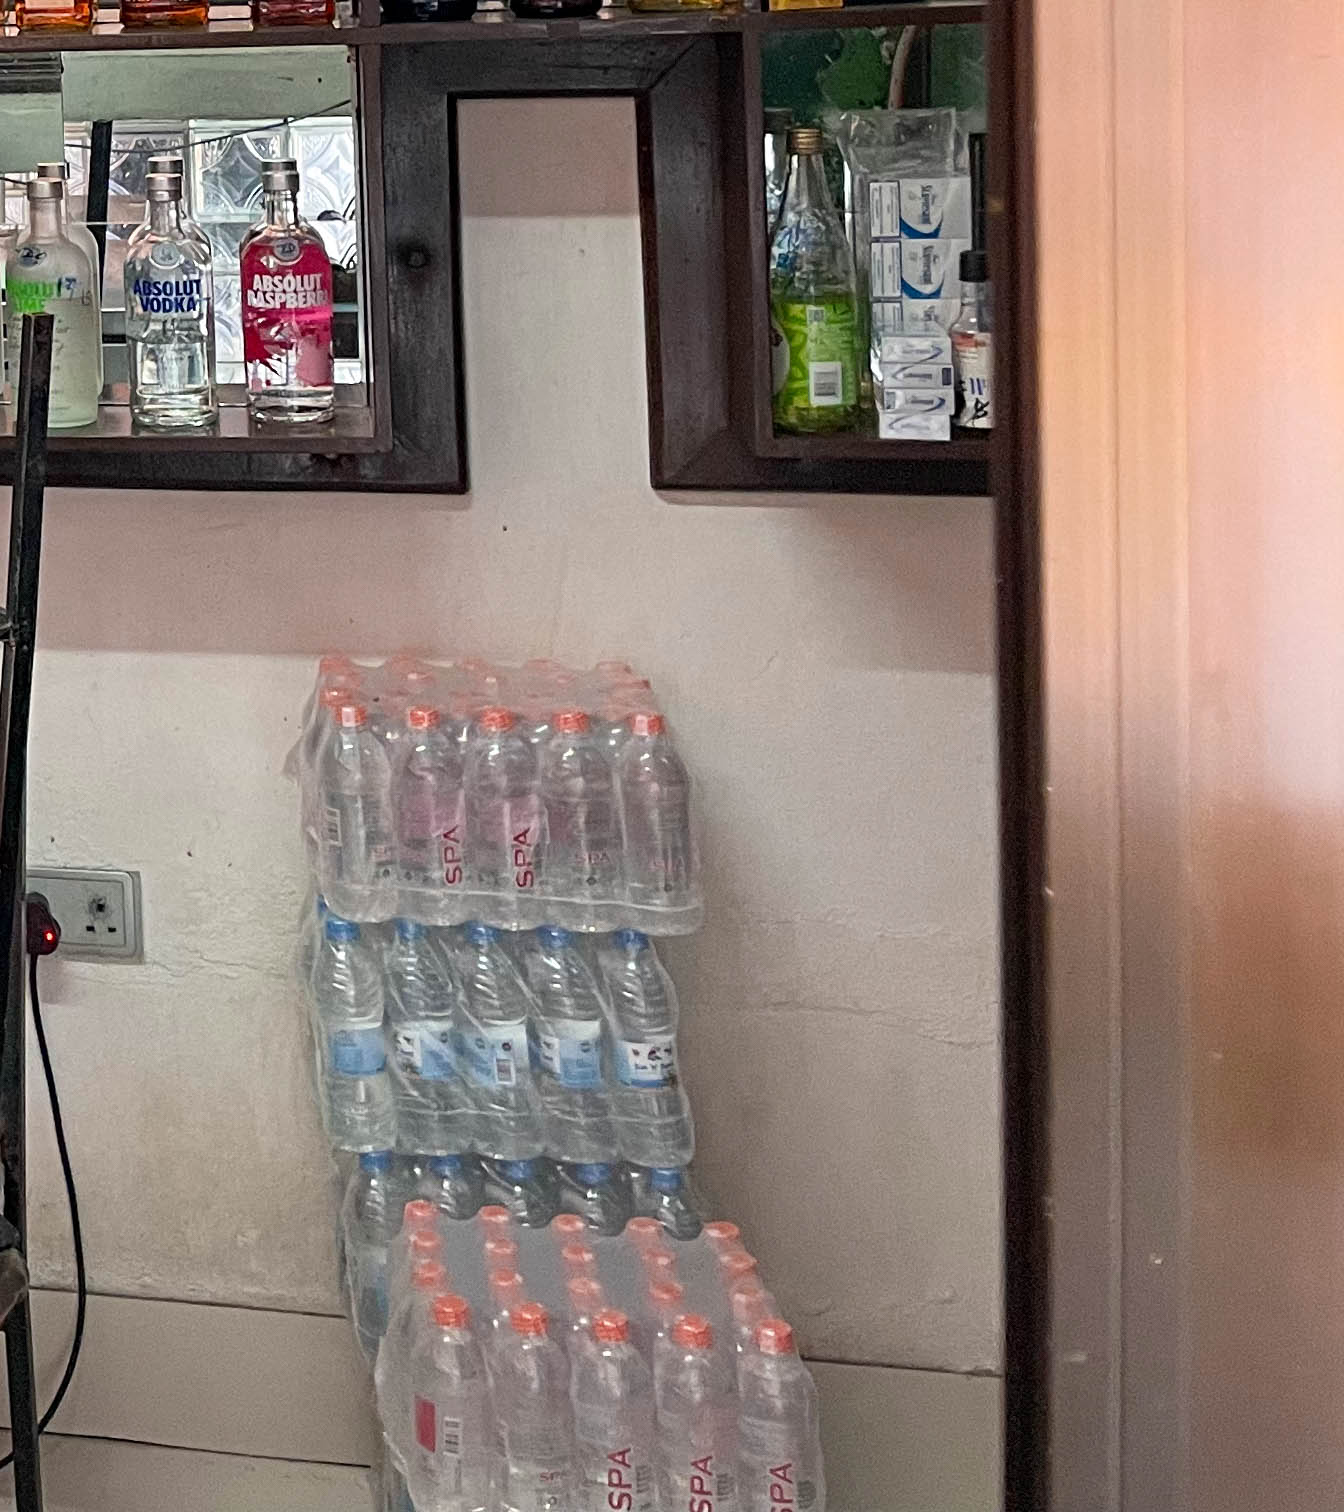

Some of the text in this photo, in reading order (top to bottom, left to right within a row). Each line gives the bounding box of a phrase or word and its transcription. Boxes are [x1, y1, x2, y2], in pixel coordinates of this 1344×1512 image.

[134, 278, 201, 296] ABSOLUT
[140, 296, 197, 313] VODKA
[253, 273, 322, 292] ABSOLUT
[442, 825, 464, 885] SPA
[513, 826, 535, 888] SPA
[608, 1448, 632, 1510] SPA
[689, 1454, 714, 1512] SPA
